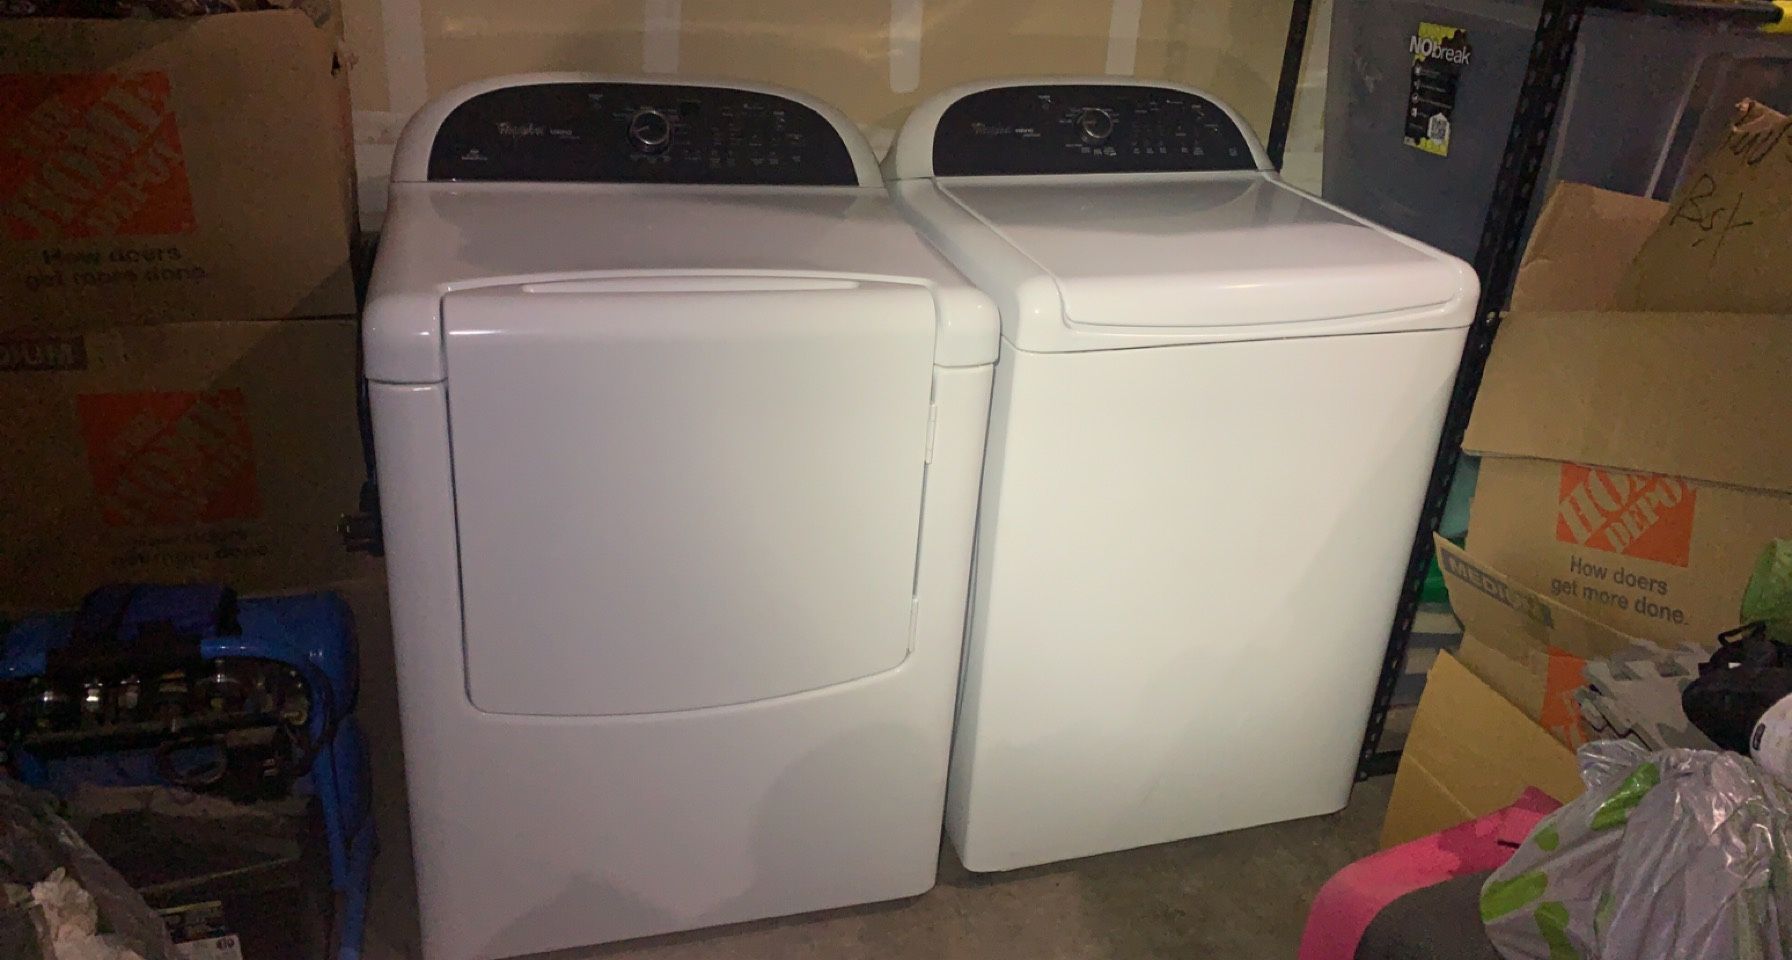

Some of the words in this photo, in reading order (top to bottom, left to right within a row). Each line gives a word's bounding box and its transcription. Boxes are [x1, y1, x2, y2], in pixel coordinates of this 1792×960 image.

[1551, 576, 1578, 600] get
[1582, 585, 1630, 611] more
[1570, 555, 1607, 581] How
[1614, 567, 1668, 596] doers
